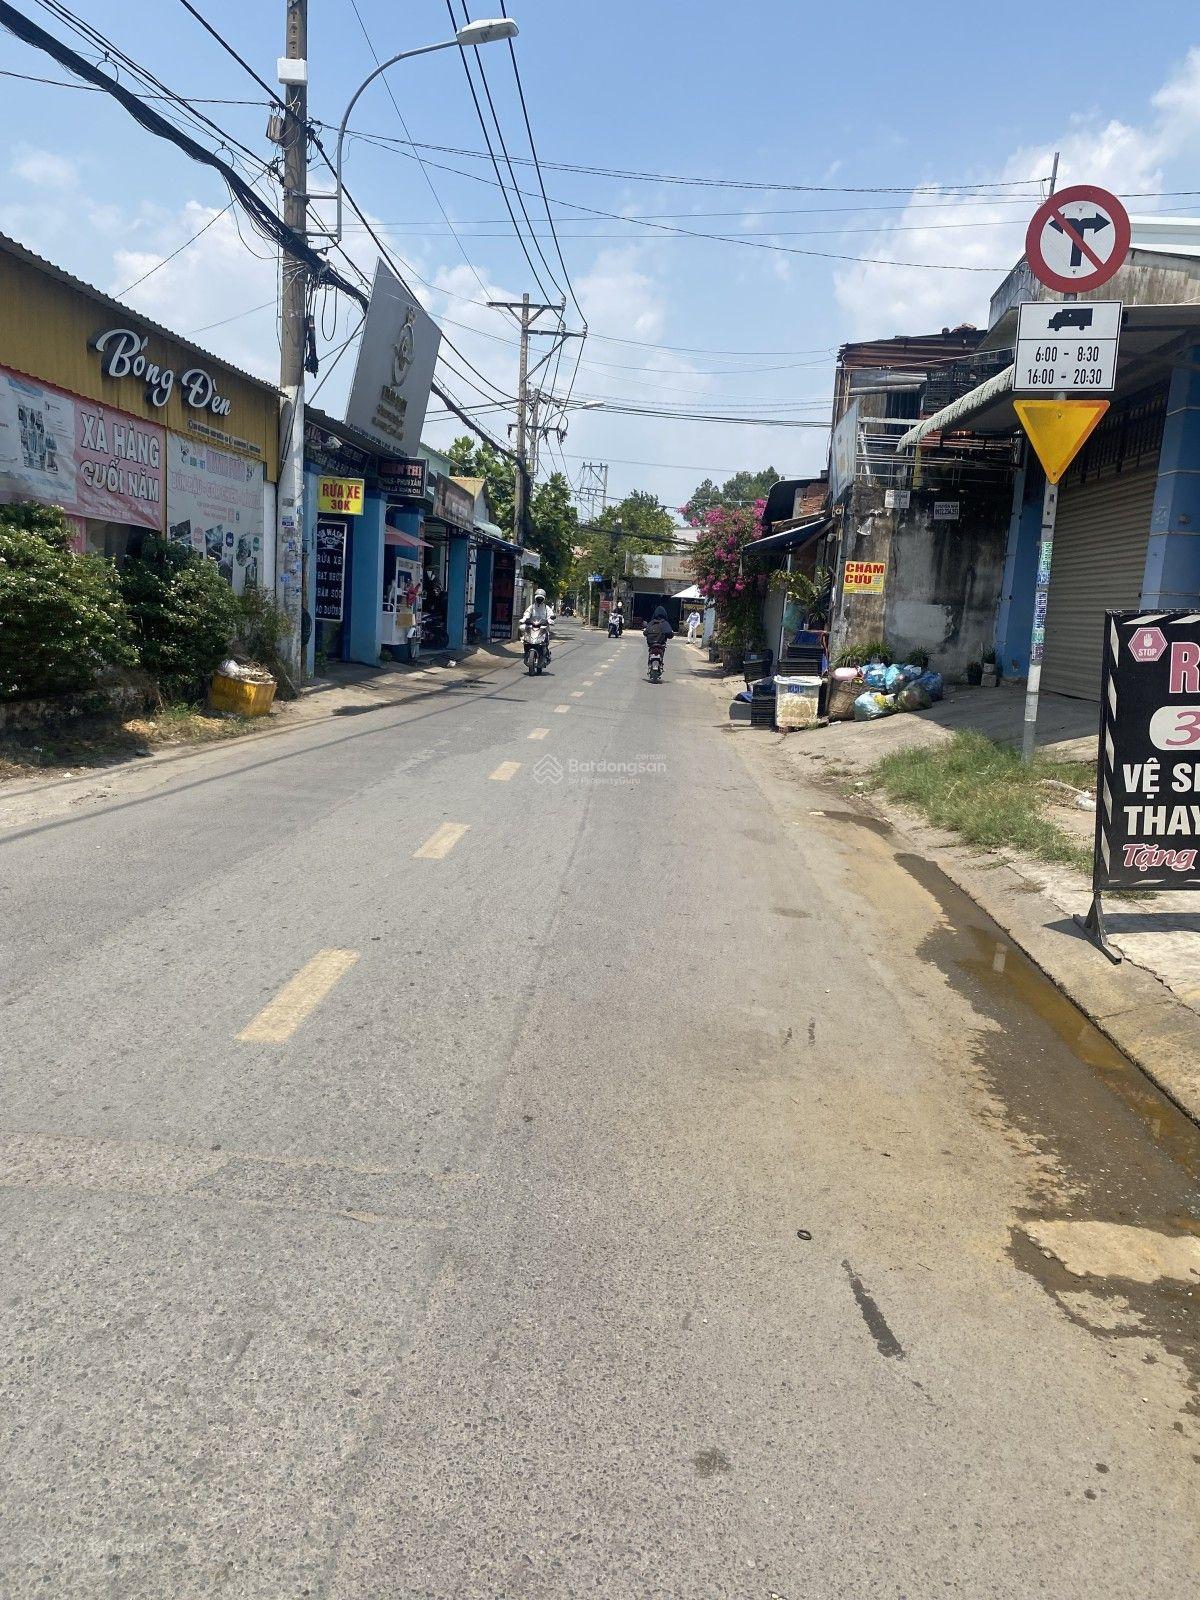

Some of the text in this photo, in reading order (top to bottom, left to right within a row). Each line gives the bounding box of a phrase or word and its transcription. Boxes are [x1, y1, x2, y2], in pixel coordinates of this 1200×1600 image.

[1035, 346, 1057, 362] 6:00
[1077, 346, 1099, 362] 8:30
[95, 328, 232, 417] Bóng Đèn
[1028, 368, 1054, 385] 16:00
[1074, 368, 1102, 385] 20:30
[81, 406, 109, 455] XẢ
[113, 420, 160, 469] HÀNG
[80, 458, 125, 495] CUỐI
[128, 469, 160, 503] NĂM
[322, 480, 360, 499] RỬA XE
[331, 499, 351, 511] 30K
[846, 562, 884, 574] CHÂM
[1138, 648, 1157, 657] STOP
[1122, 757, 1160, 799] VỆ
[1122, 843, 1198, 872] Tặng
